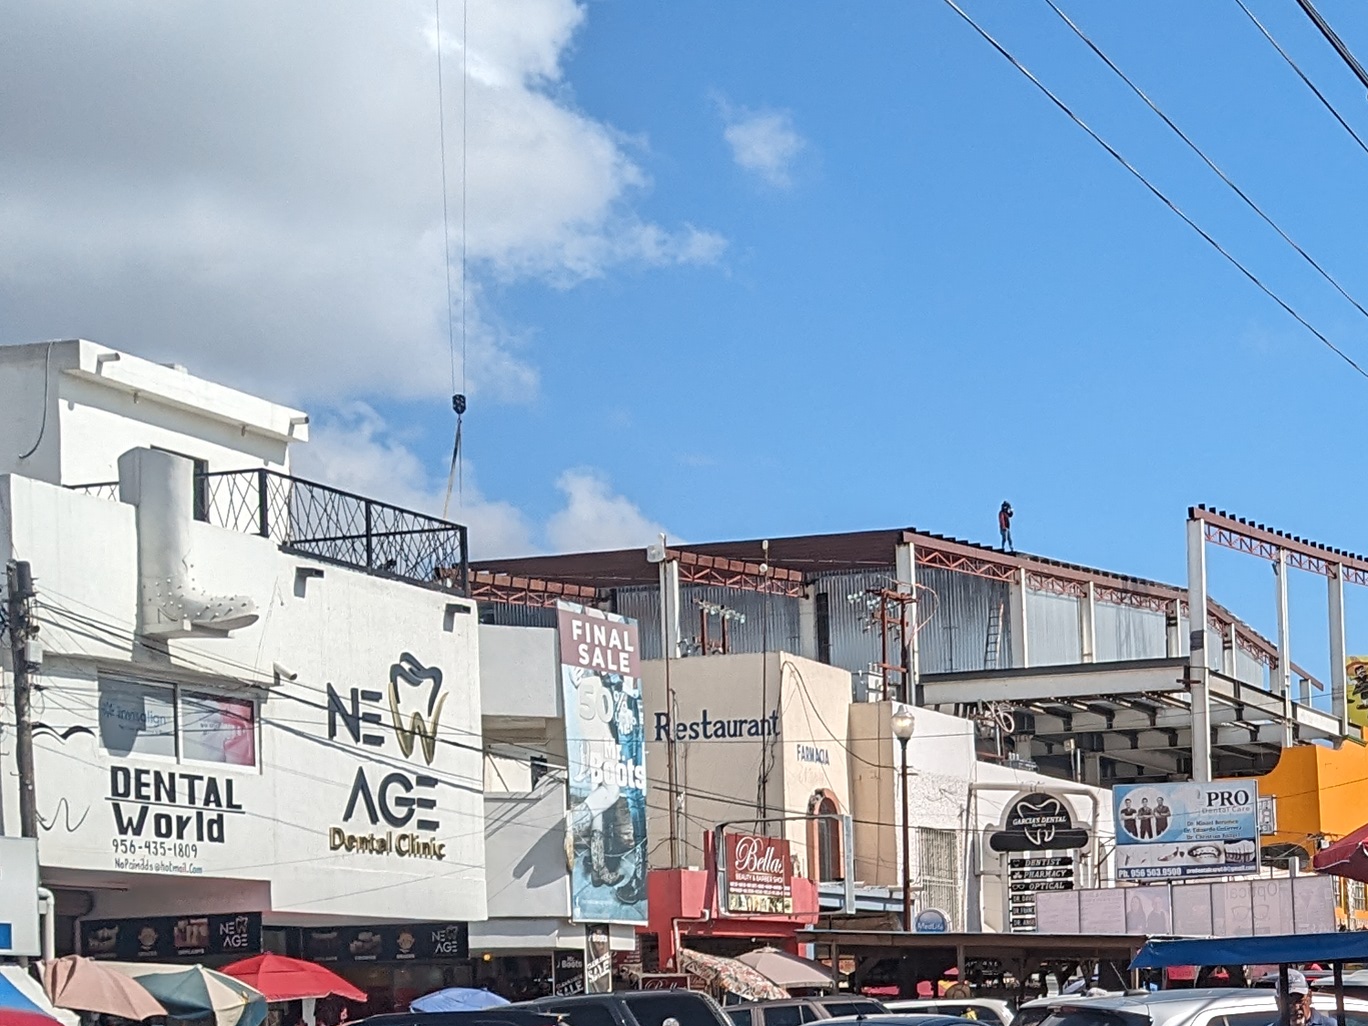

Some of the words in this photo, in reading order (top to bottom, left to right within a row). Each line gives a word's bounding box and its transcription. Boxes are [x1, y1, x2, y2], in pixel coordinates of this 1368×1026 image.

[571, 619, 634, 653] FINAL
[578, 643, 631, 674] SALE
[326, 653, 449, 766] NEW
[653, 709, 781, 742] Restaurant
[603, 741, 626, 761] Mr.
[796, 744, 830, 766] FARMACIA
[589, 751, 647, 791] Boots
[110, 765, 243, 810] DENTAL
[342, 765, 440, 832] AGE
[1206, 789, 1250, 808] PRO
[1042, 815, 1067, 825] DENTAL
[1201, 806, 1231, 815] Dental
[1232, 804, 1251, 813] Care
[112, 801, 226, 844] World
[112, 838, 199, 859] 956-435-1809
[328, 826, 393, 856] Dental
[395, 832, 446, 861] Clinic
[1024, 858, 1062, 867] DENTIST
[1023, 869, 1067, 879] PHARMACY
[1028, 881, 1065, 890] OPTICAL
[223, 933, 249, 948] AGE
[434, 940, 458, 954] AGE
